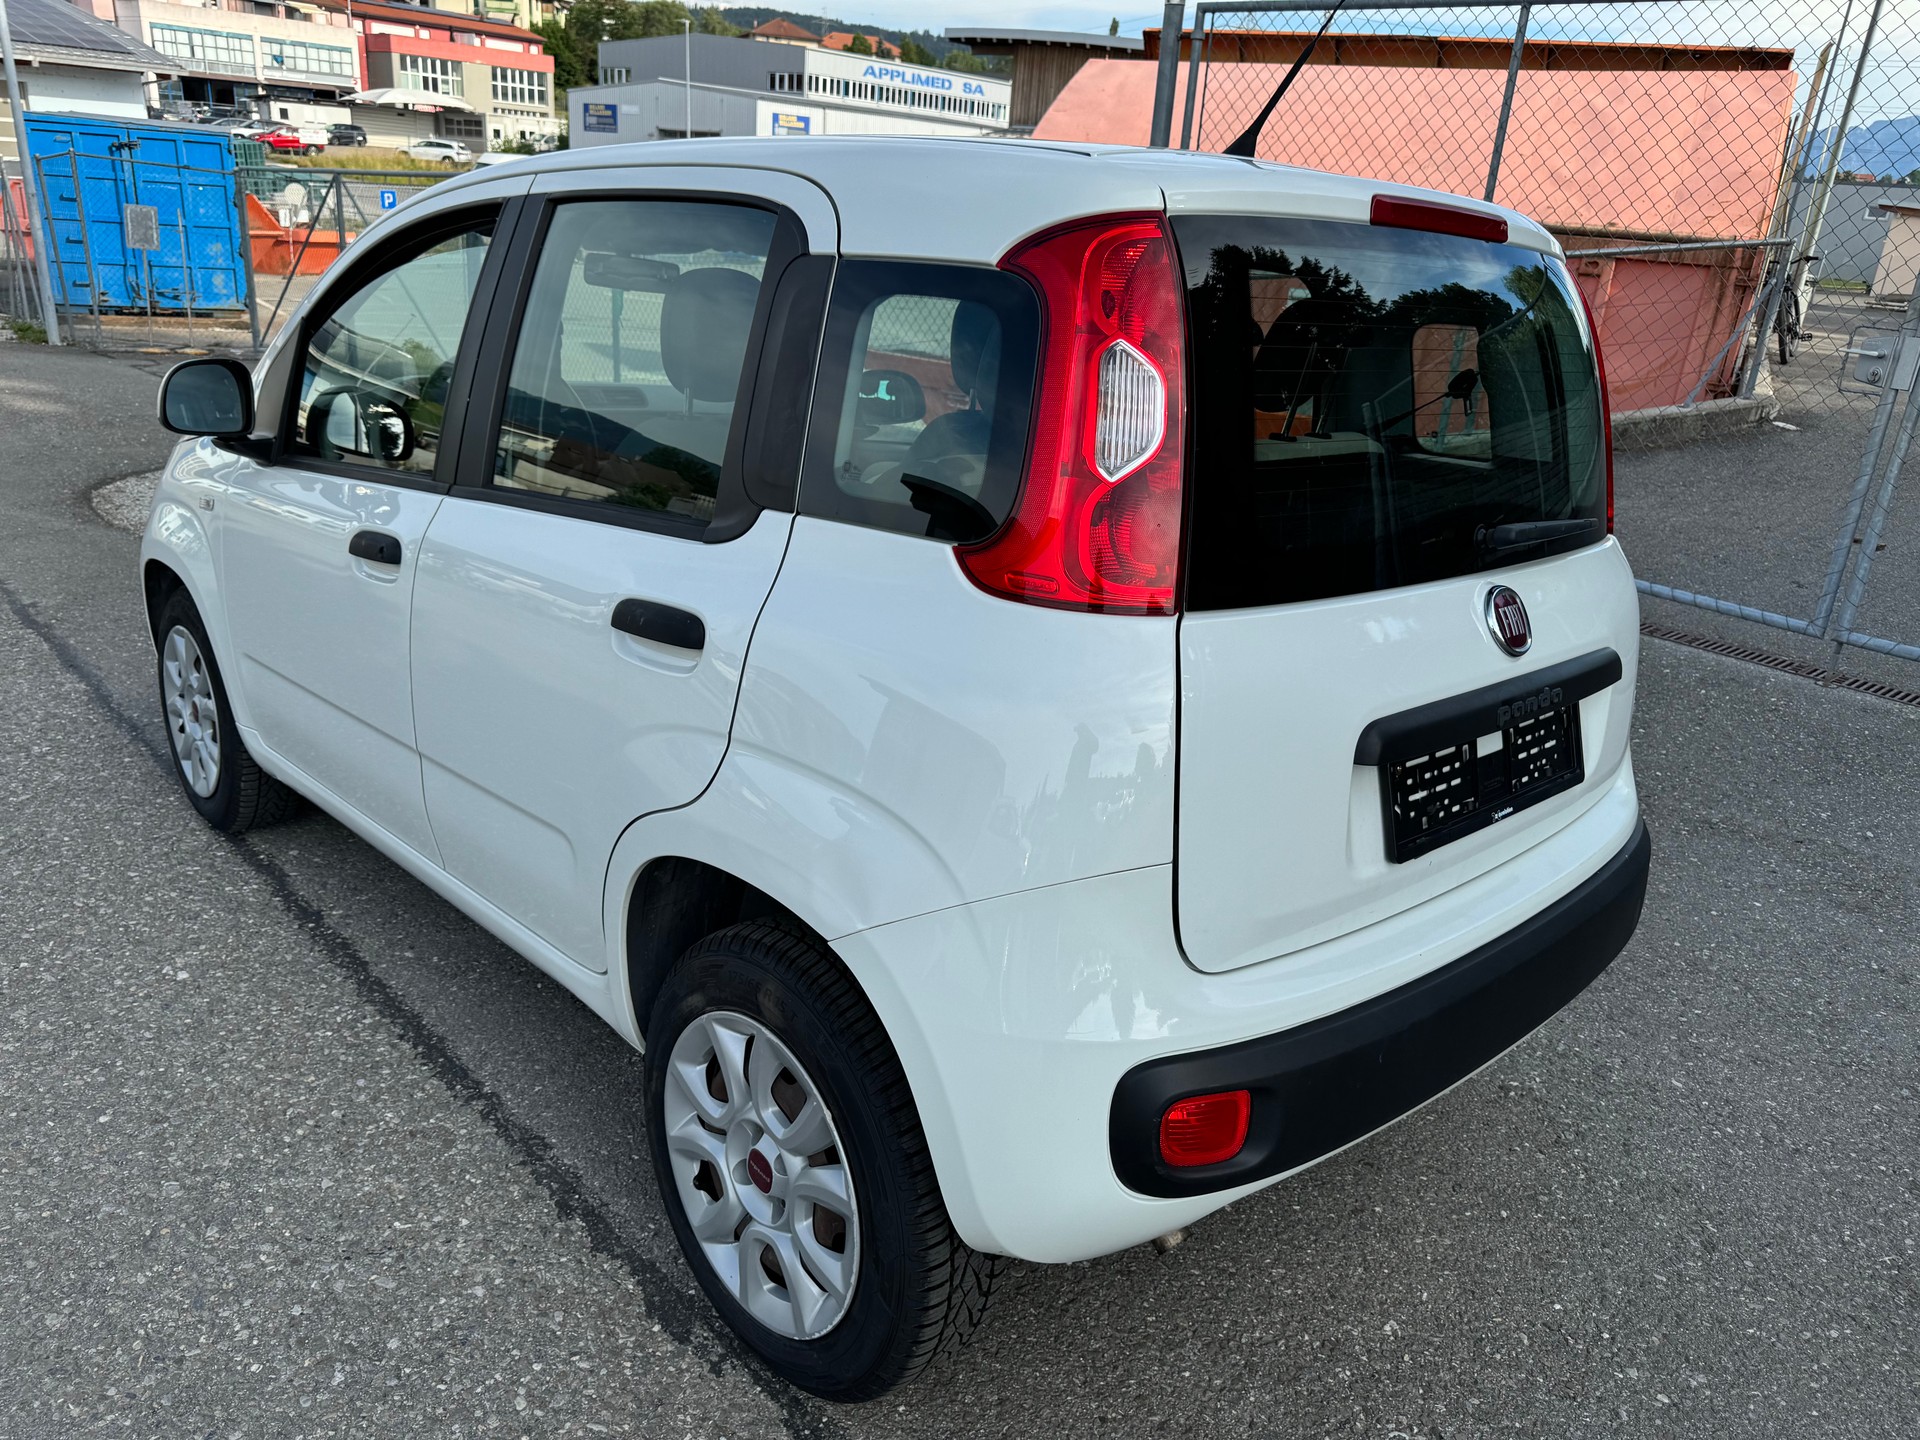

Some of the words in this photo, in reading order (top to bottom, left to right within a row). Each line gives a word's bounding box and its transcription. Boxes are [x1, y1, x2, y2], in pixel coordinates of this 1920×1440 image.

[863, 65, 953, 91] APPLIMED
[963, 82, 986, 97] SA
[383, 193, 394, 207] P
[1498, 603, 1526, 638] FIAT
[1496, 687, 1563, 727] panda
